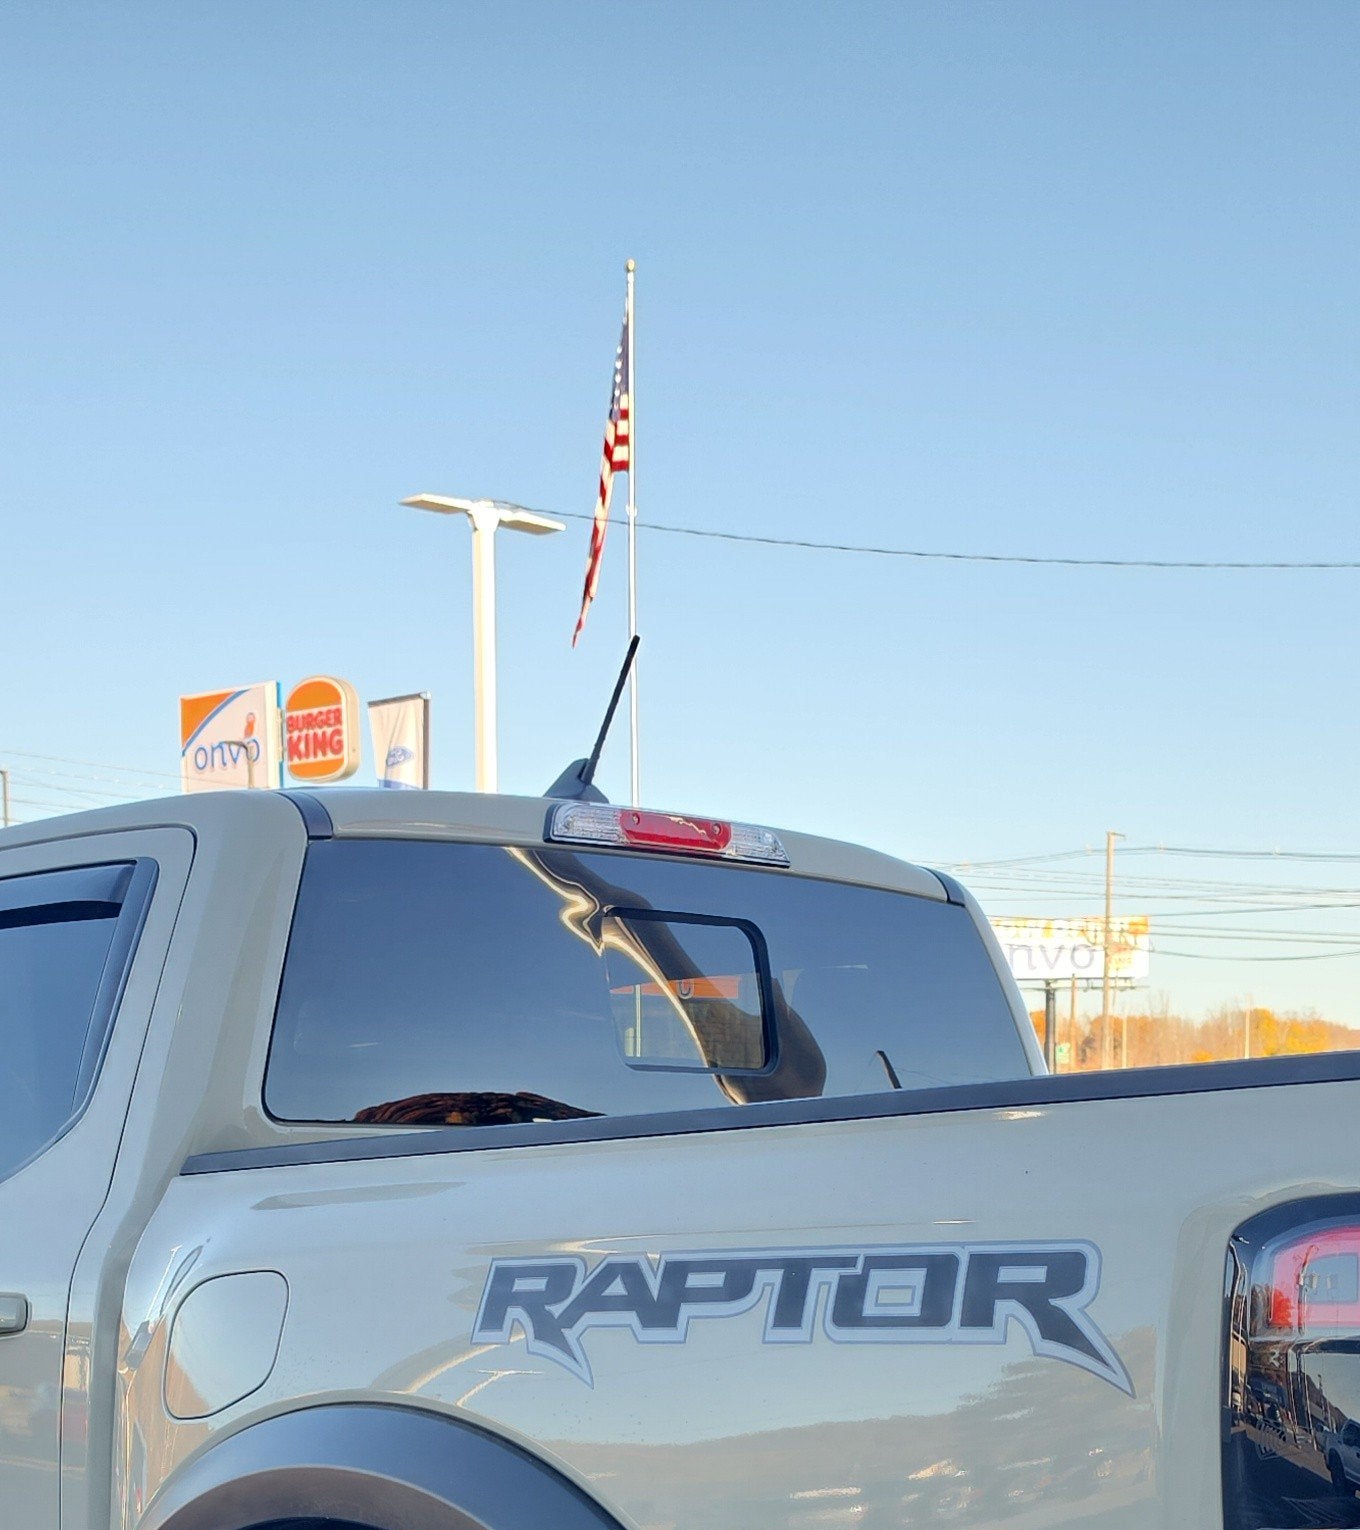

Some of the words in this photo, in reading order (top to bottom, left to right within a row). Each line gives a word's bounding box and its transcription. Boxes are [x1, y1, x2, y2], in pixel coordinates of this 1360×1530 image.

[286, 707, 343, 733] BURGER
[194, 738, 261, 770] onvo
[287, 728, 344, 762] KING
[1007, 943, 1096, 970] nvo
[471, 1239, 1137, 1399] RAPTOR
